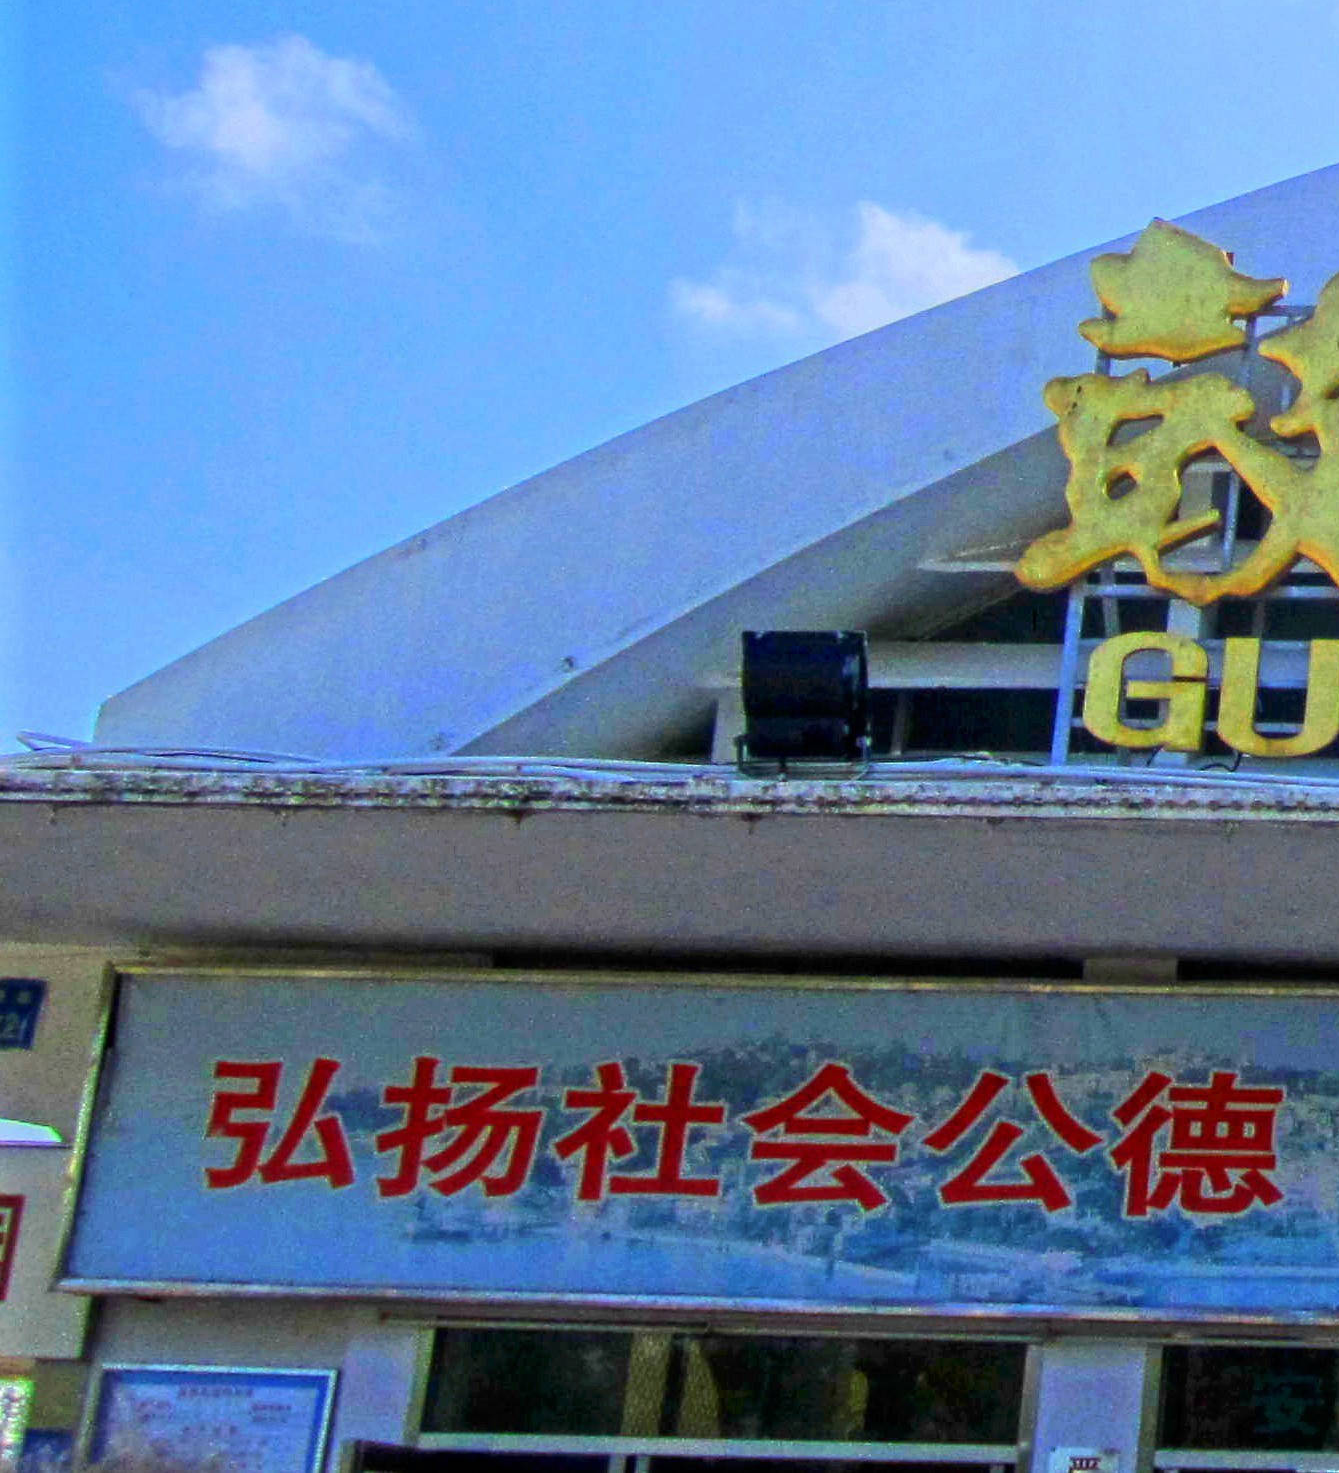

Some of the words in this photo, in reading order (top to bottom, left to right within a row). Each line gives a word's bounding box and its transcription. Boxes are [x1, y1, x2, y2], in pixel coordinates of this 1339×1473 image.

[206, 1057, 1286, 1217] 弘扬社会公德
